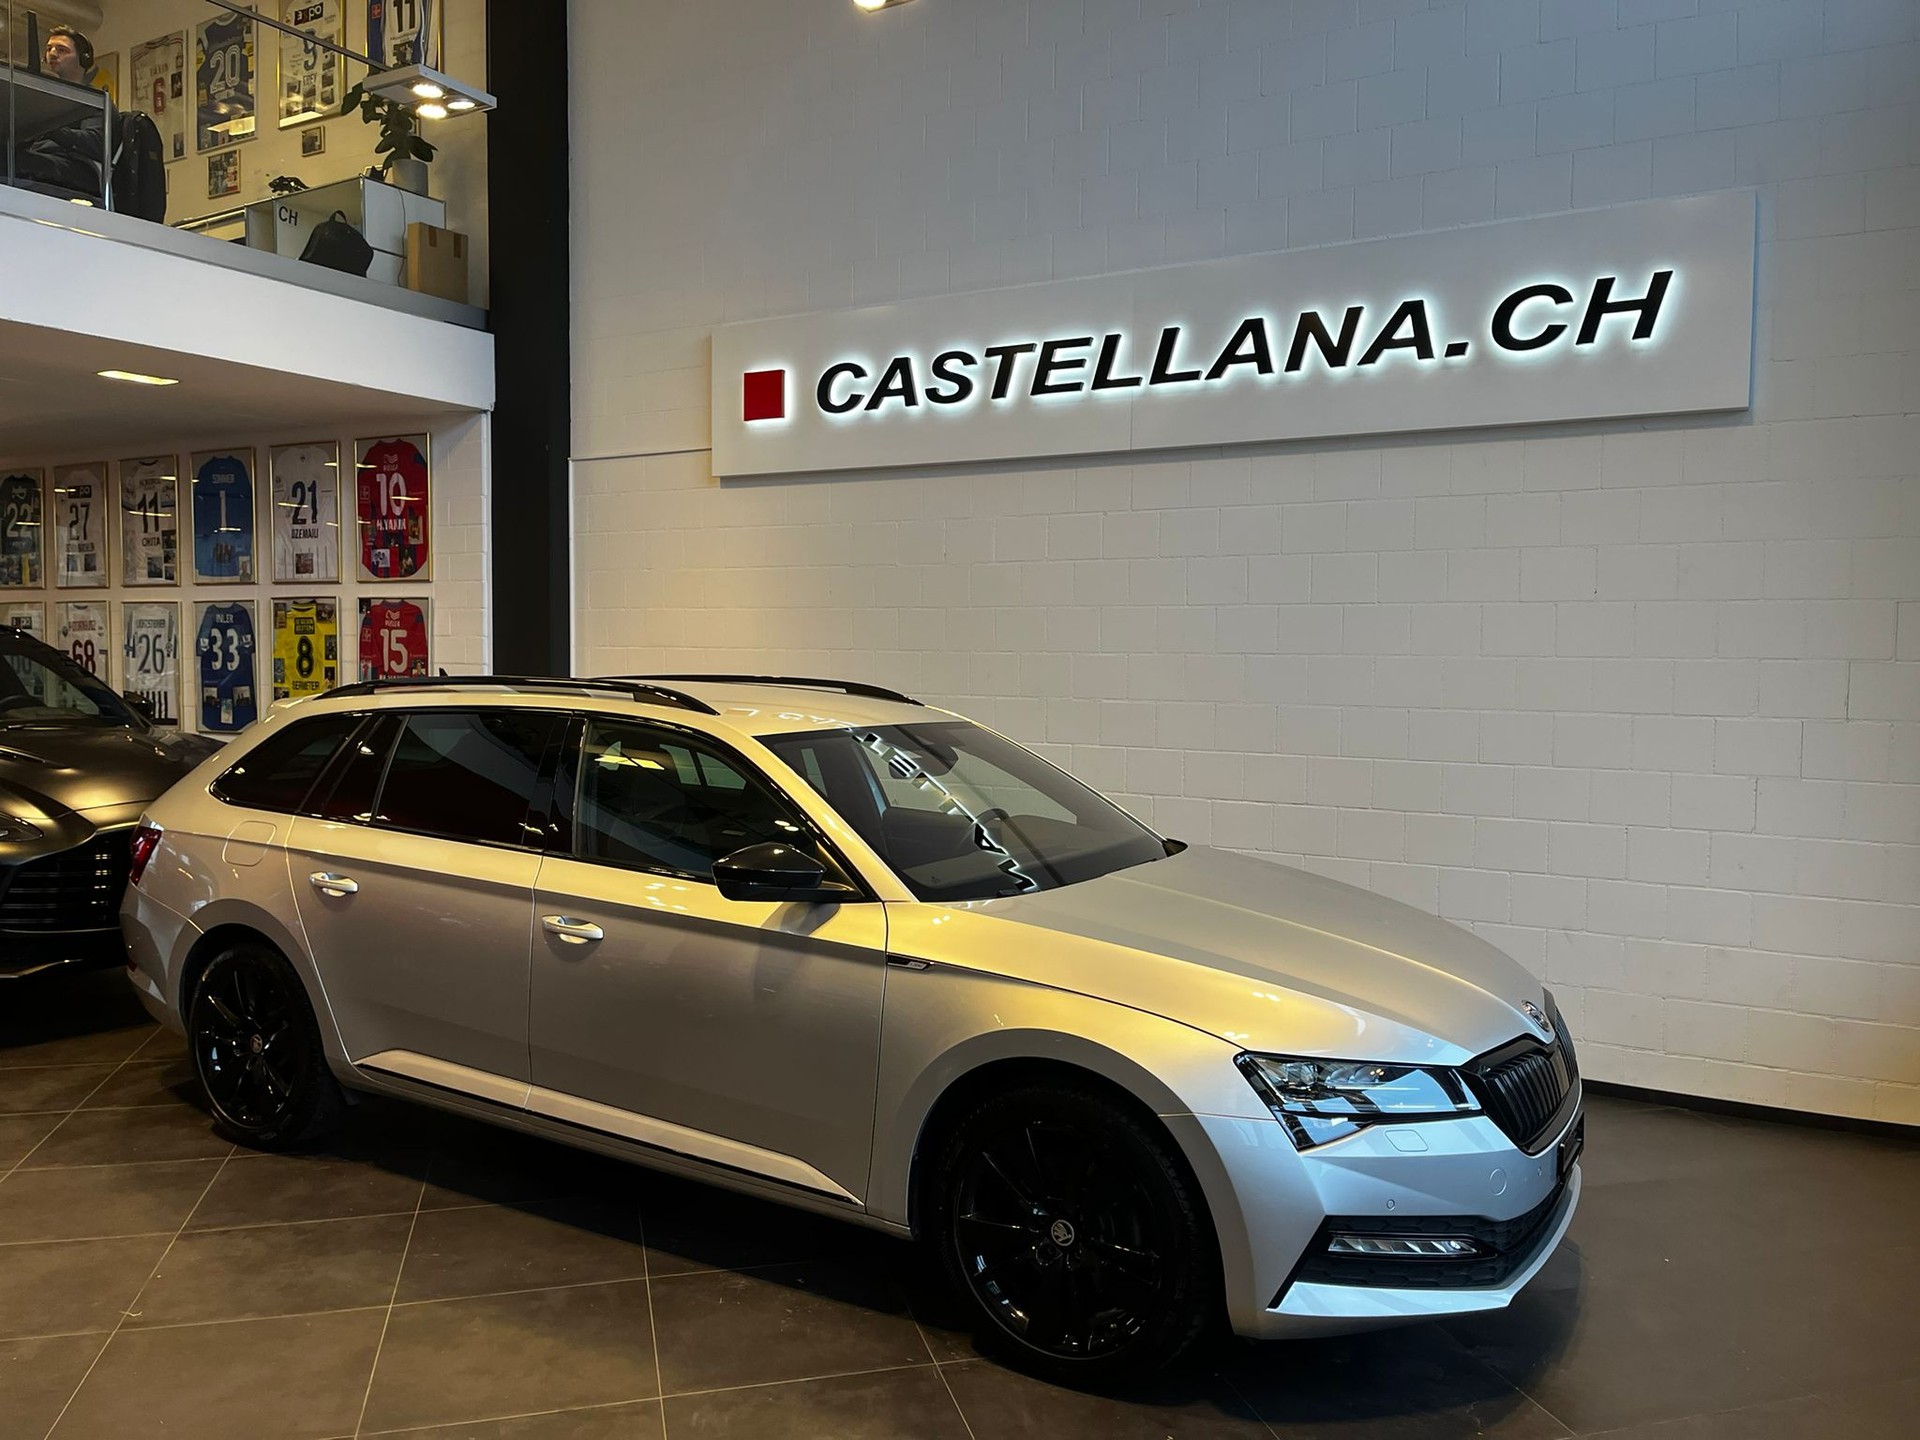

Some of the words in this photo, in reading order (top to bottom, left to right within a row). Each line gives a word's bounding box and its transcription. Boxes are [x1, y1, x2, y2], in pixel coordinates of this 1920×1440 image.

[391, 0, 416, 33] 11
[209, 44, 241, 95] 20
[278, 205, 298, 226] CH
[815, 269, 1674, 415] CASTELLANA.CH
[138, 491, 160, 534] 11
[219, 490, 227, 532] 1
[291, 480, 318, 525] 21
[376, 472, 407, 516] 10
[7, 502, 32, 539] 22
[69, 502, 91, 541] 27
[72, 639, 97, 676] 68
[138, 634, 165, 674] 26
[210, 628, 240, 671] 33
[296, 635, 314, 679] 8
[380, 628, 408, 673] 15
